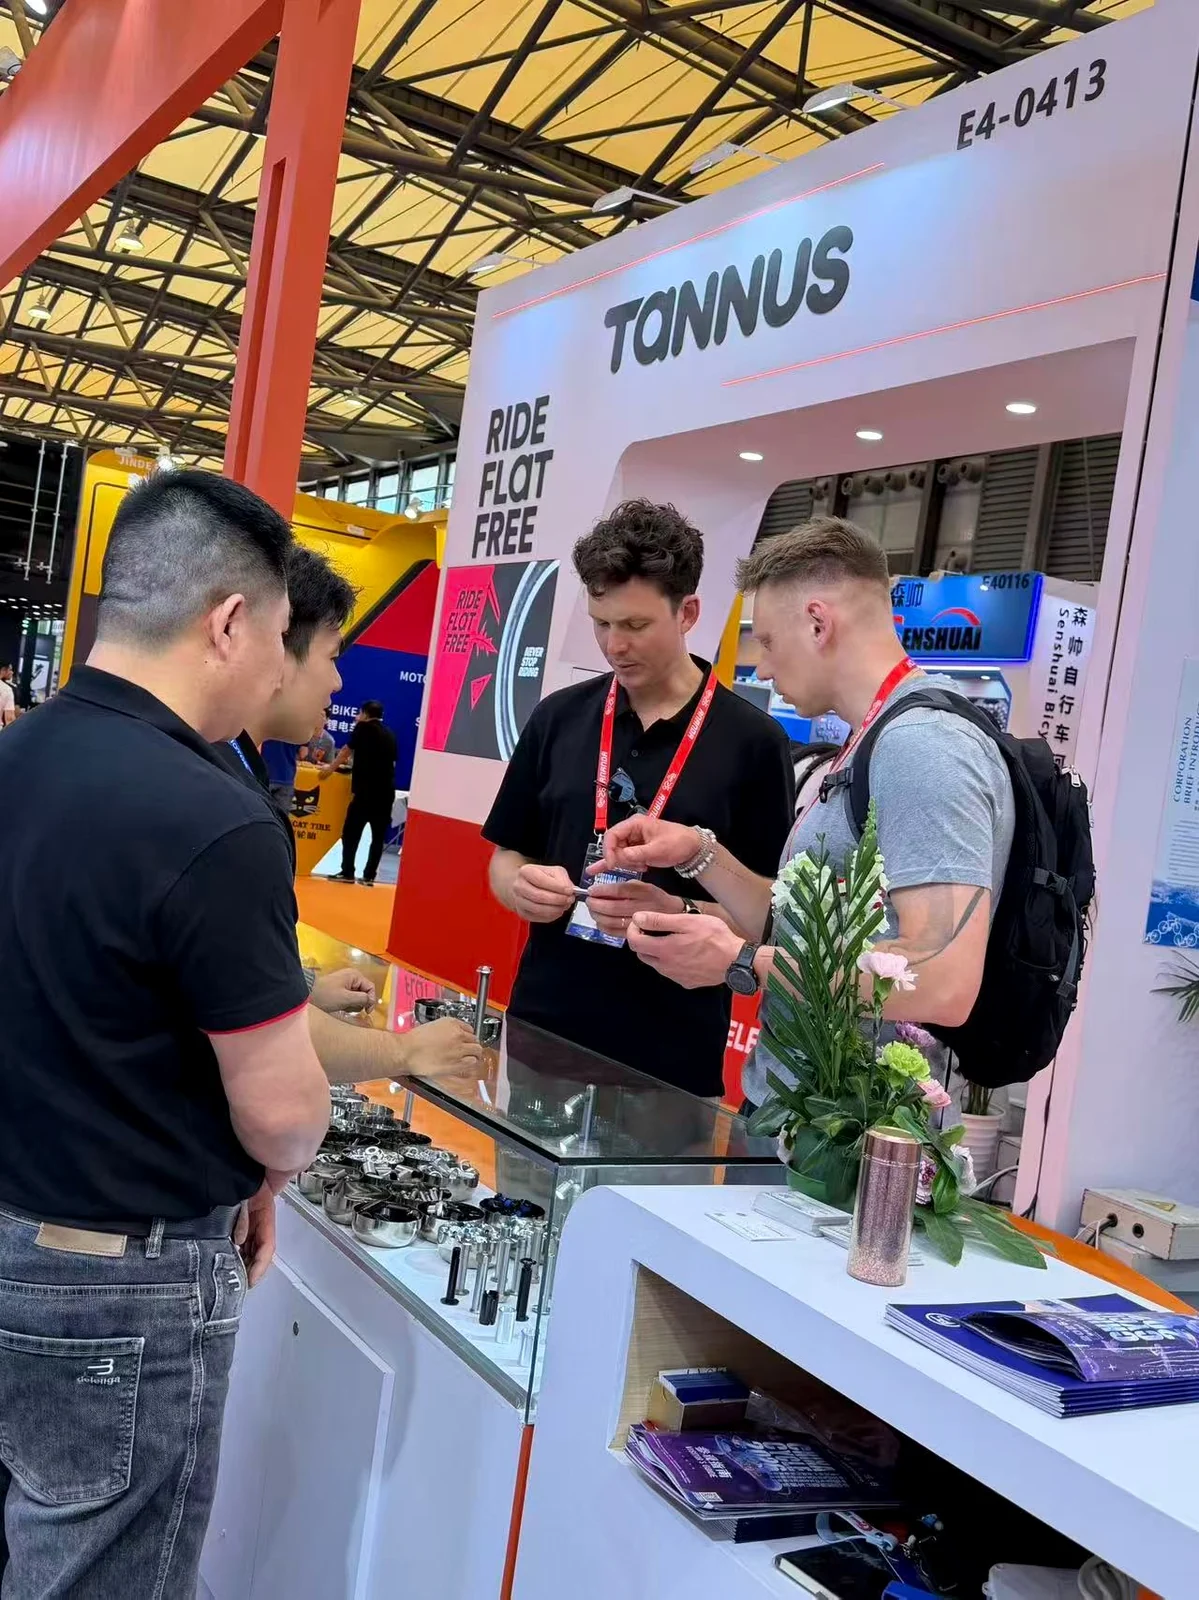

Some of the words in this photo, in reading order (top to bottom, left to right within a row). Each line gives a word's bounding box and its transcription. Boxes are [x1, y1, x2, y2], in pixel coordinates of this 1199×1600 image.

[956, 58, 1107, 151] E4-0413
[486, 395, 550, 455] RIDE
[471, 505, 538, 559] FREE
[456, 589, 484, 610] RIDE
[442, 633, 470, 653] FREE
[897, 626, 982, 651] ENSHUAI
[1047, 607, 1070, 694] Senshuai
[520, 657, 538, 668] STOP
[1173, 716, 1192, 803] CORPORATION
[1184, 773, 1194, 804] BRIEF
